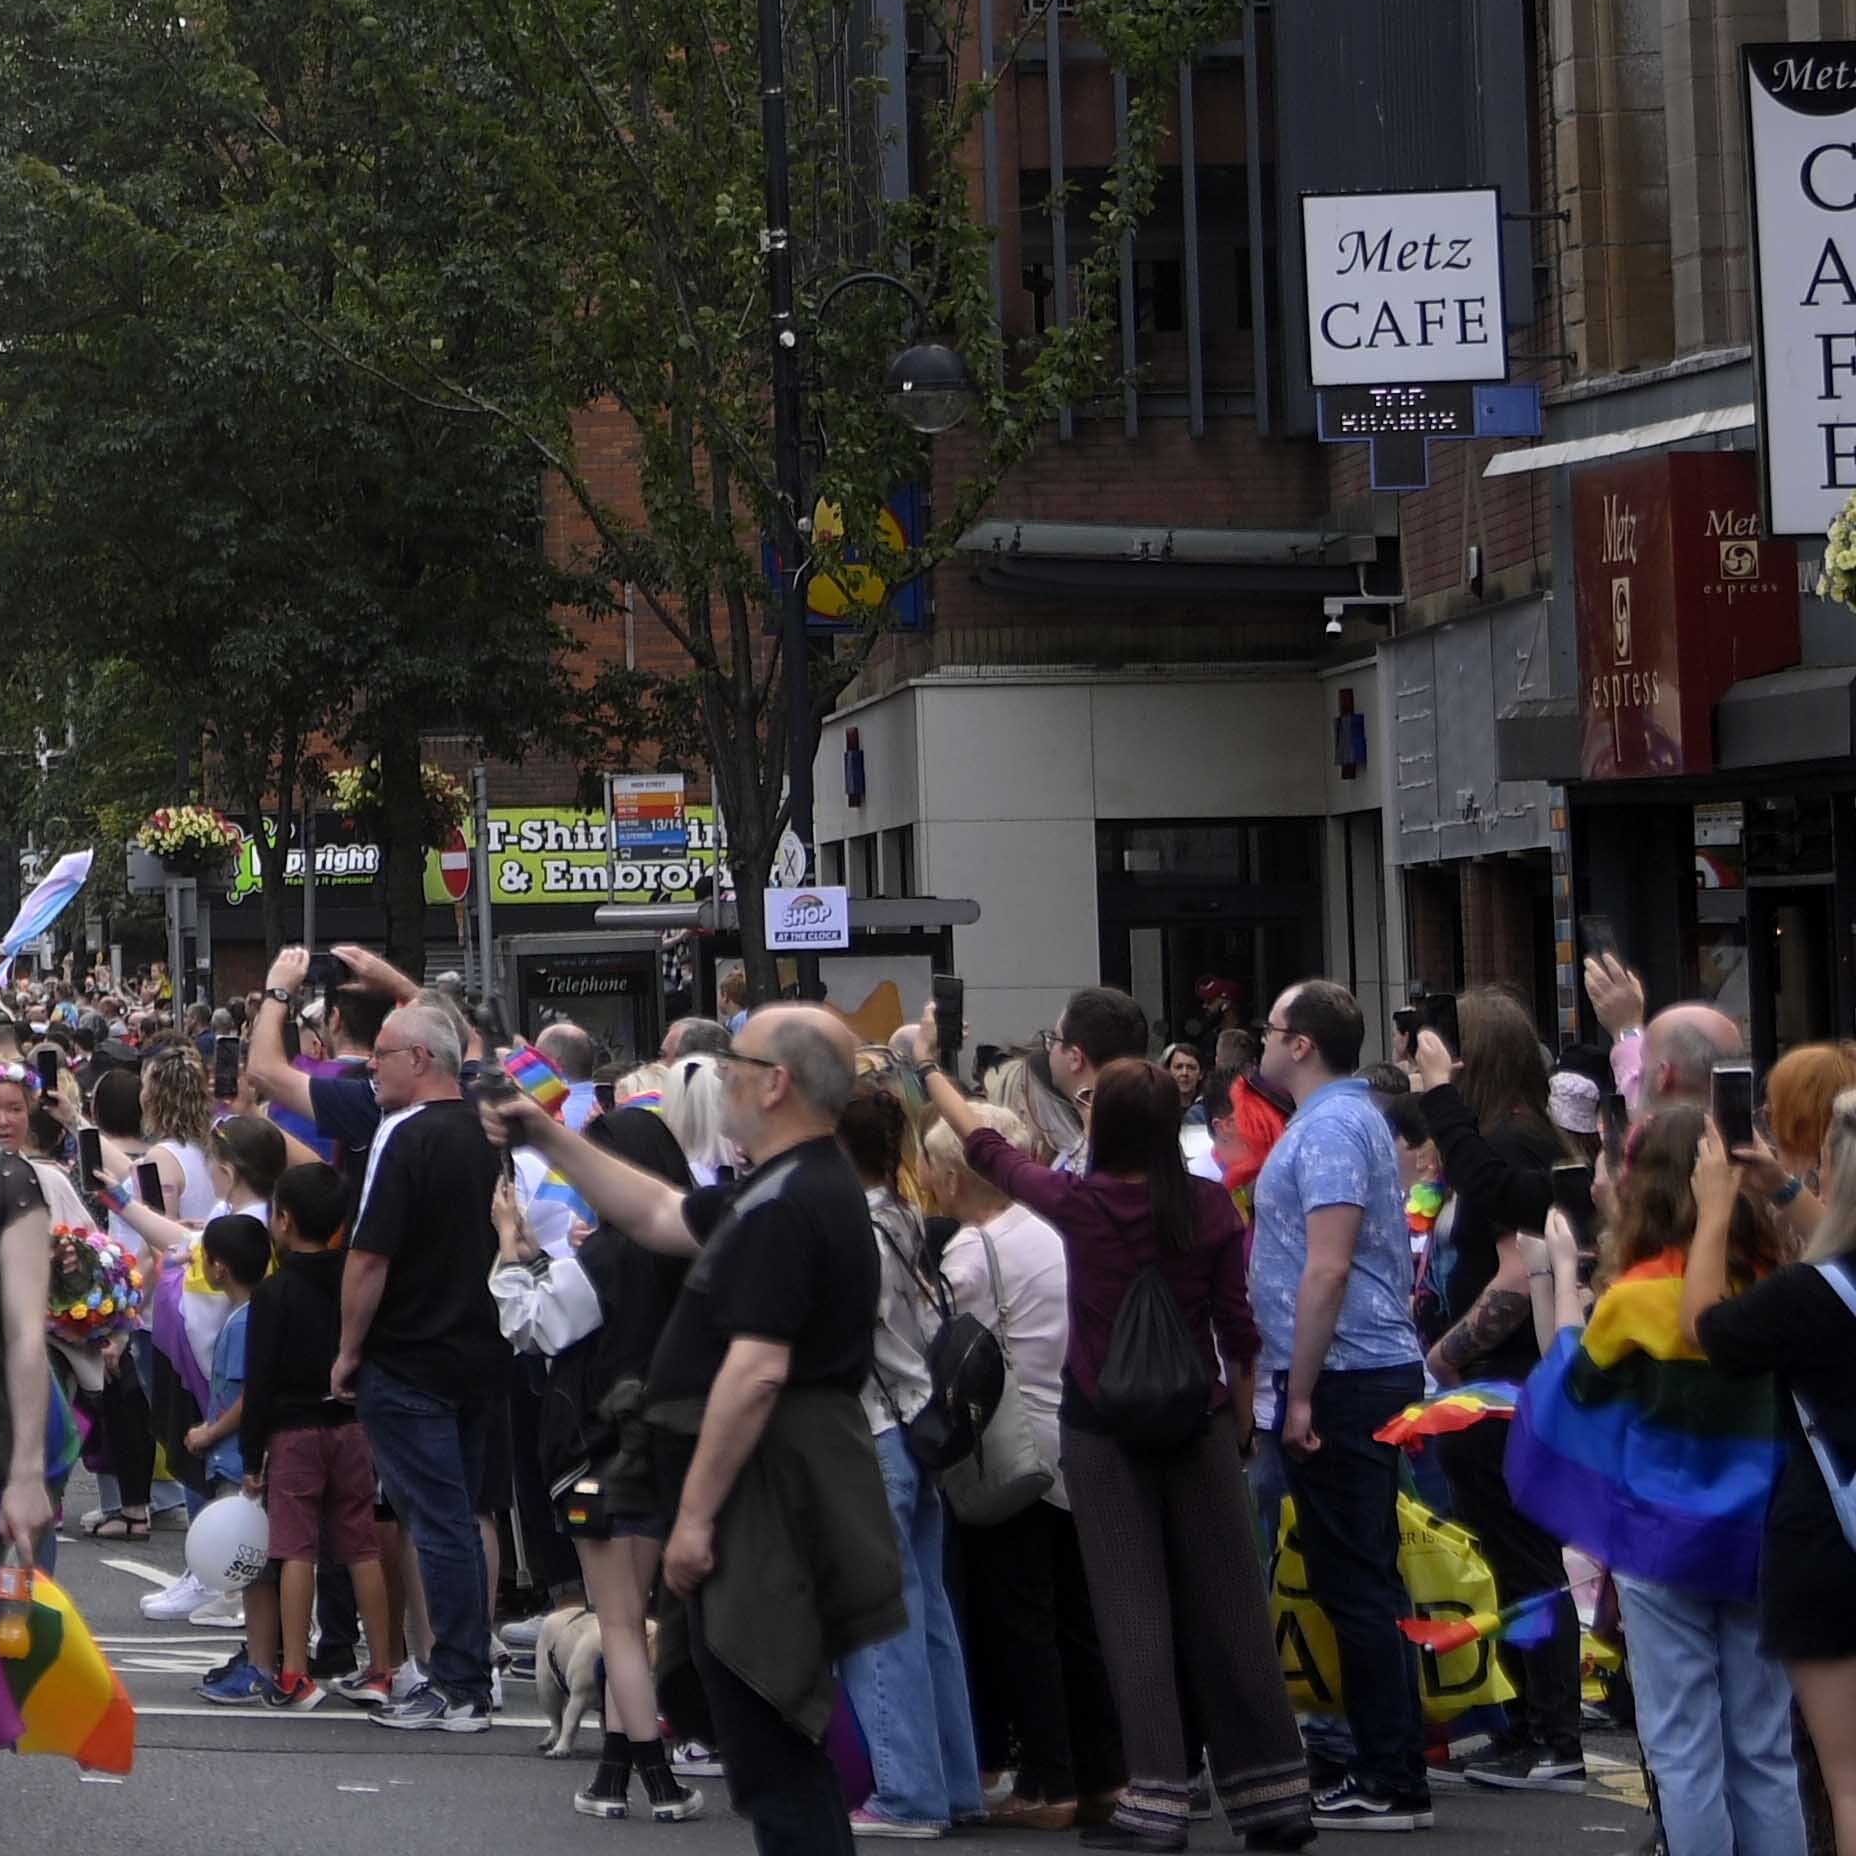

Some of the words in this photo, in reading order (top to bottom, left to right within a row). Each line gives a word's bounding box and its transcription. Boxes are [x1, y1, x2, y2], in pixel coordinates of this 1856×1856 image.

[1336, 228, 1472, 275] Metz
[1320, 296, 1488, 350] CAFE
[1601, 495, 1638, 565] Metz
[1704, 510, 1760, 537] Met
[1592, 669, 1660, 762] espress
[674, 792, 680, 804] 1
[673, 806, 681, 817] 2
[650, 818, 682, 831] 13/14
[499, 860, 533, 892] &
[542, 857, 735, 891] Embroid
[784, 905, 832, 927] SHOP
[777, 932, 790, 942] AT
[808, 931, 839, 941] CLOCK
[546, 976, 628, 996] Telephone
